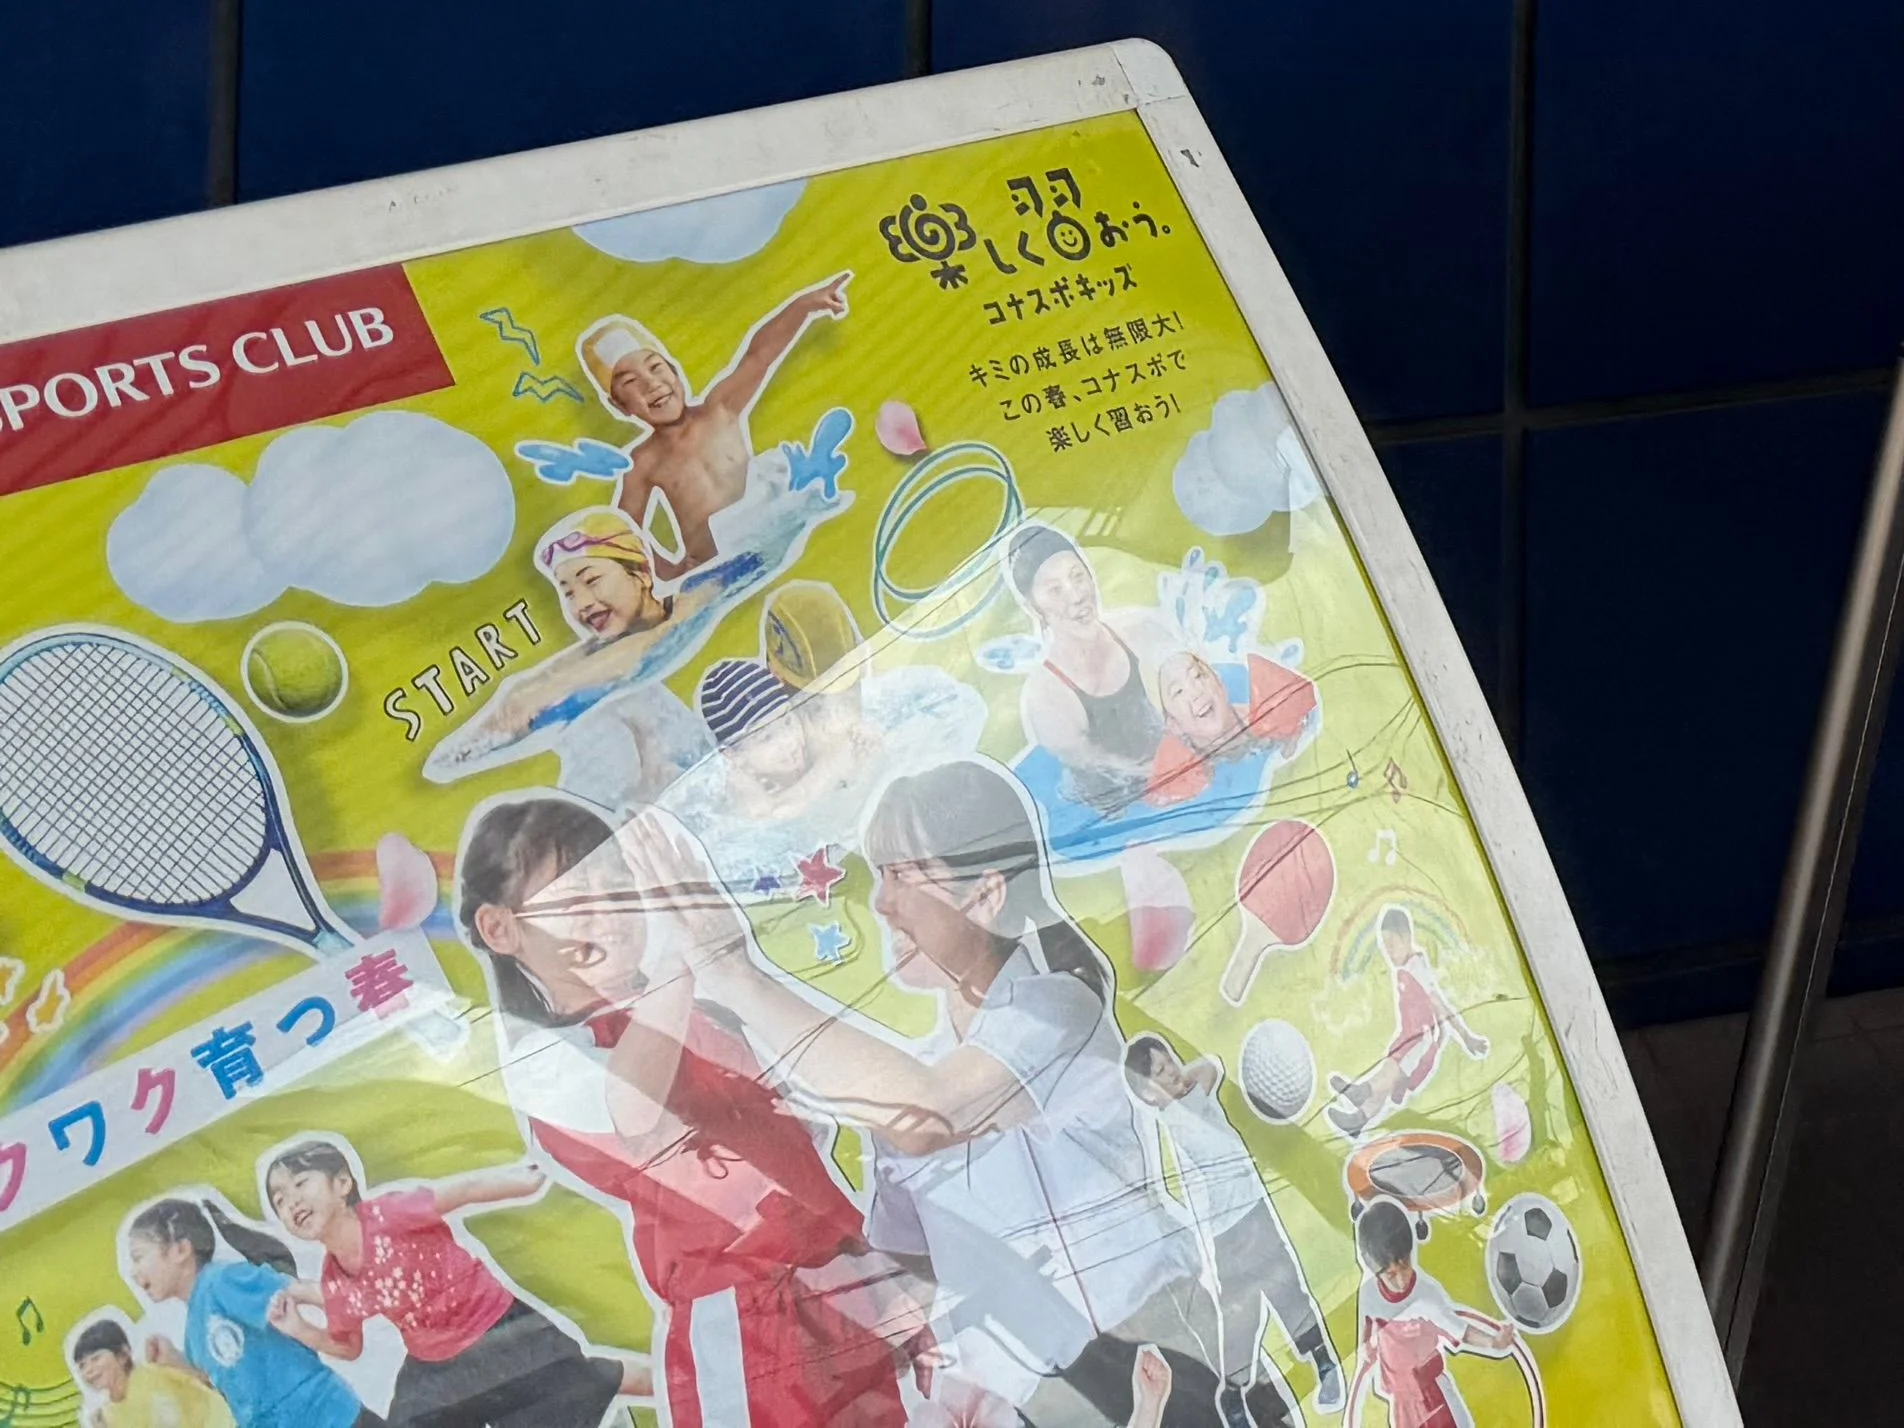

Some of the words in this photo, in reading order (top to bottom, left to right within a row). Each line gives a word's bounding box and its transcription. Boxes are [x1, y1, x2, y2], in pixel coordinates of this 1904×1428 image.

[983, 263, 1138, 325] コナスポキッズ
[0, 344, 221, 433] PORTS
[232, 307, 394, 375] CLUB
[969, 310, 1185, 388] キミの成長は無限大!
[999, 349, 1188, 422] この春、コナスポで
[1046, 393, 1183, 453] 楽しく習おう!
[383, 598, 542, 742] START
